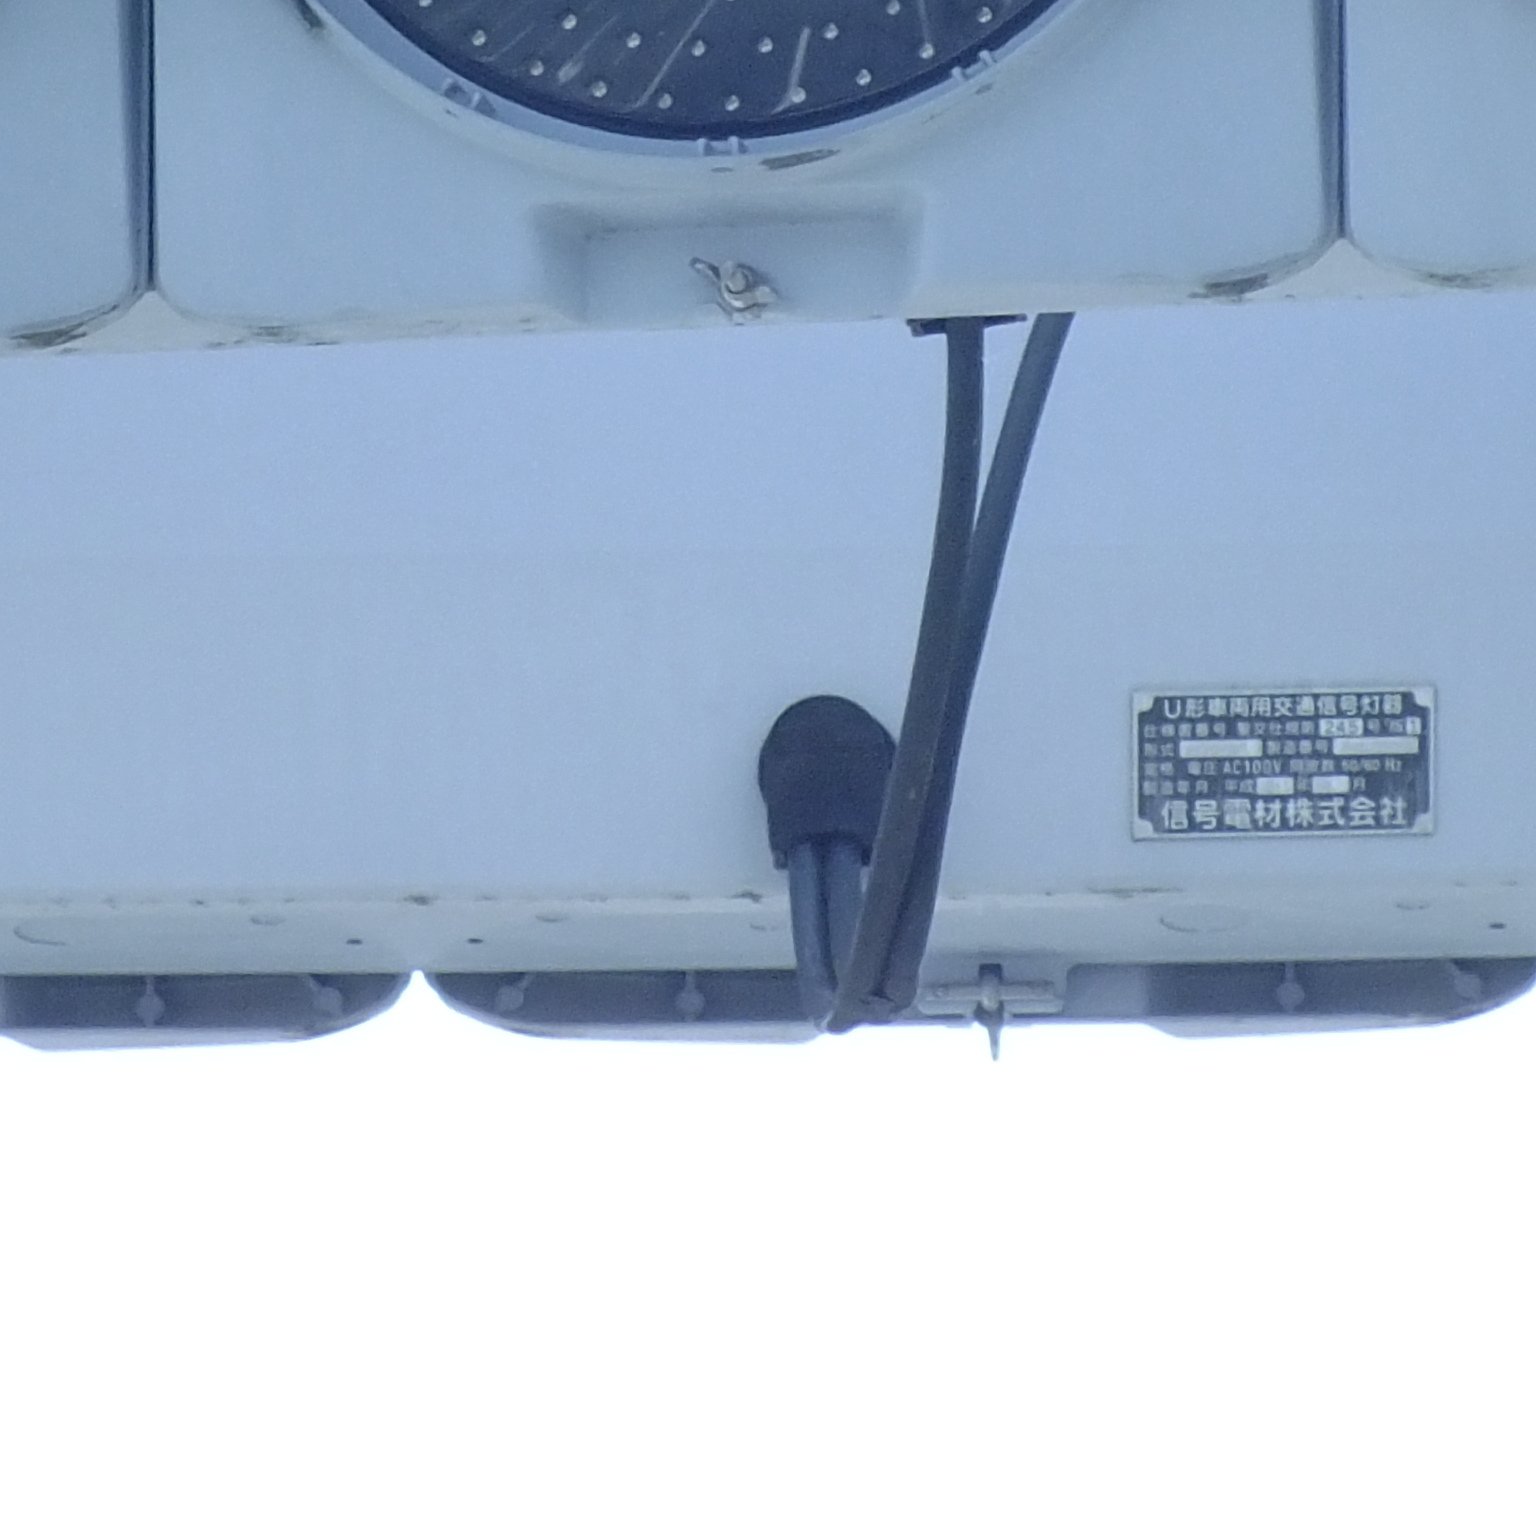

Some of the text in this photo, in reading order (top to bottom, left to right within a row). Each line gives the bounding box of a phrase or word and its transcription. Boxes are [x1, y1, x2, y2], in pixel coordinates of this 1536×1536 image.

[1161, 797, 1407, 829] 信号電材株式会社
